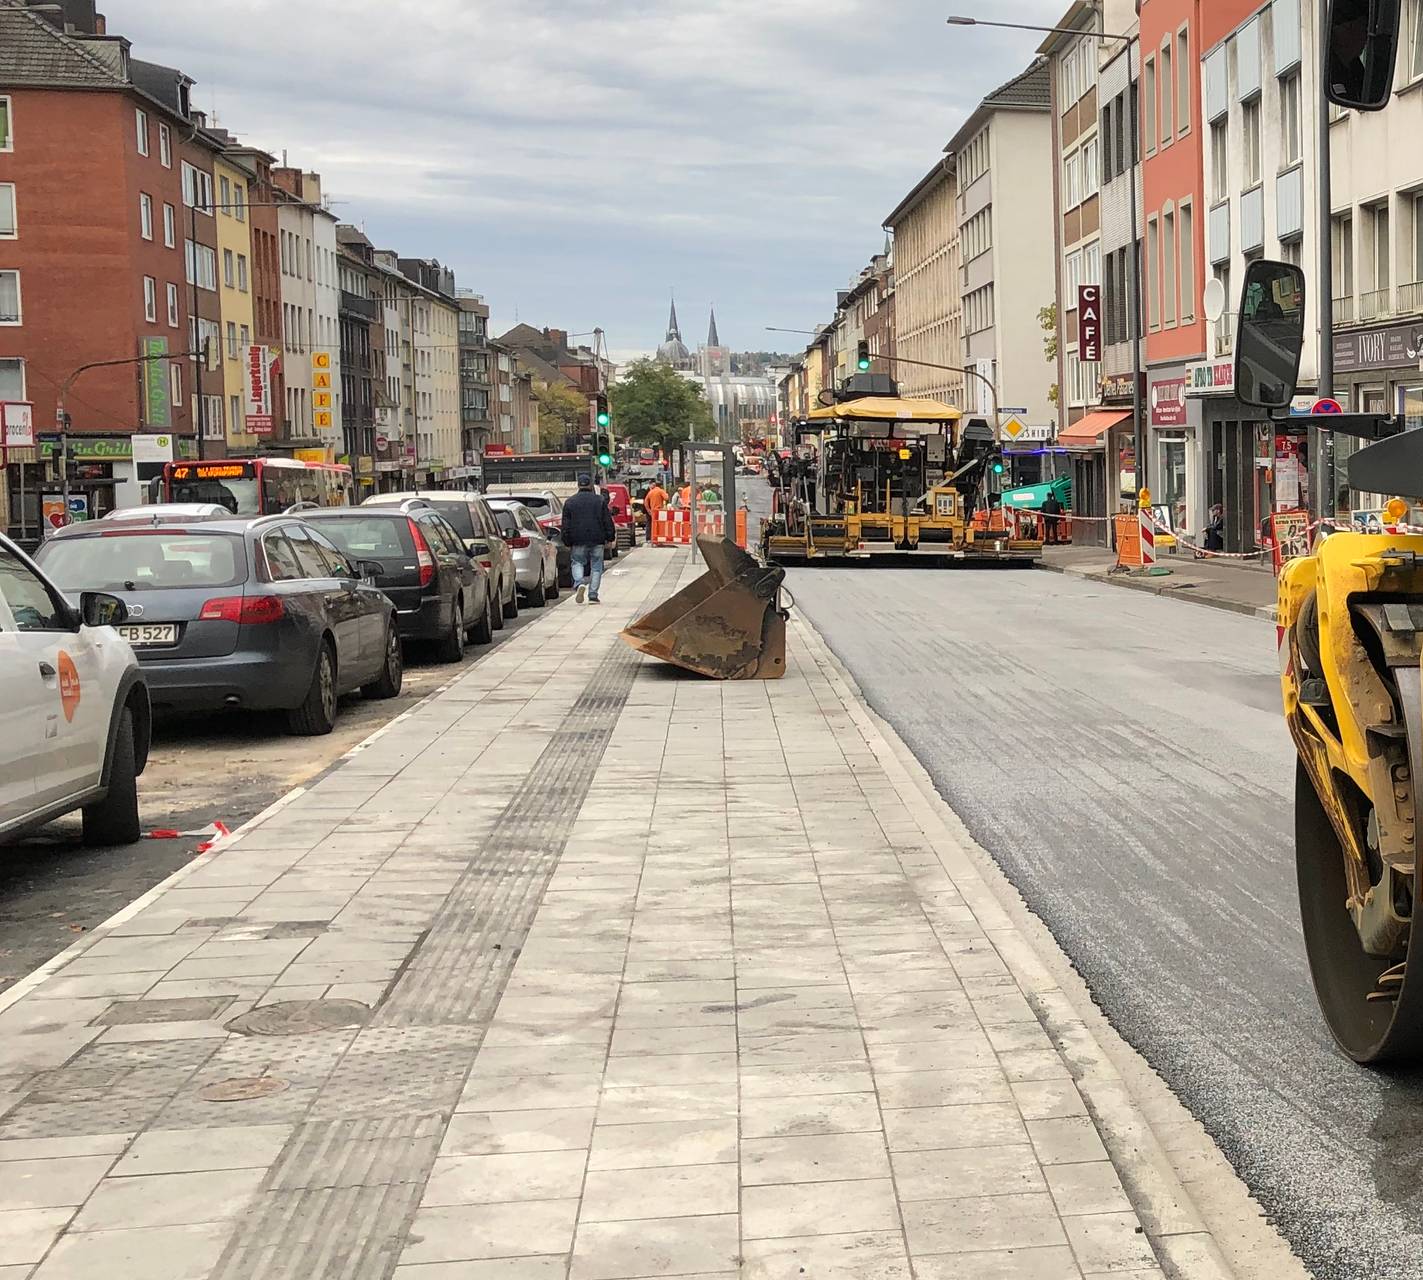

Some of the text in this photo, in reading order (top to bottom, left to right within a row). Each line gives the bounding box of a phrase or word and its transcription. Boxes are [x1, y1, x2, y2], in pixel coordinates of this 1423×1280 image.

[1083, 288, 1097, 359] CAFÉ
[1359, 332, 1386, 363] IVORY
[317, 355, 328, 426] CAFÉ
[174, 468, 189, 479] 47
[143, 626, 172, 640] 527
